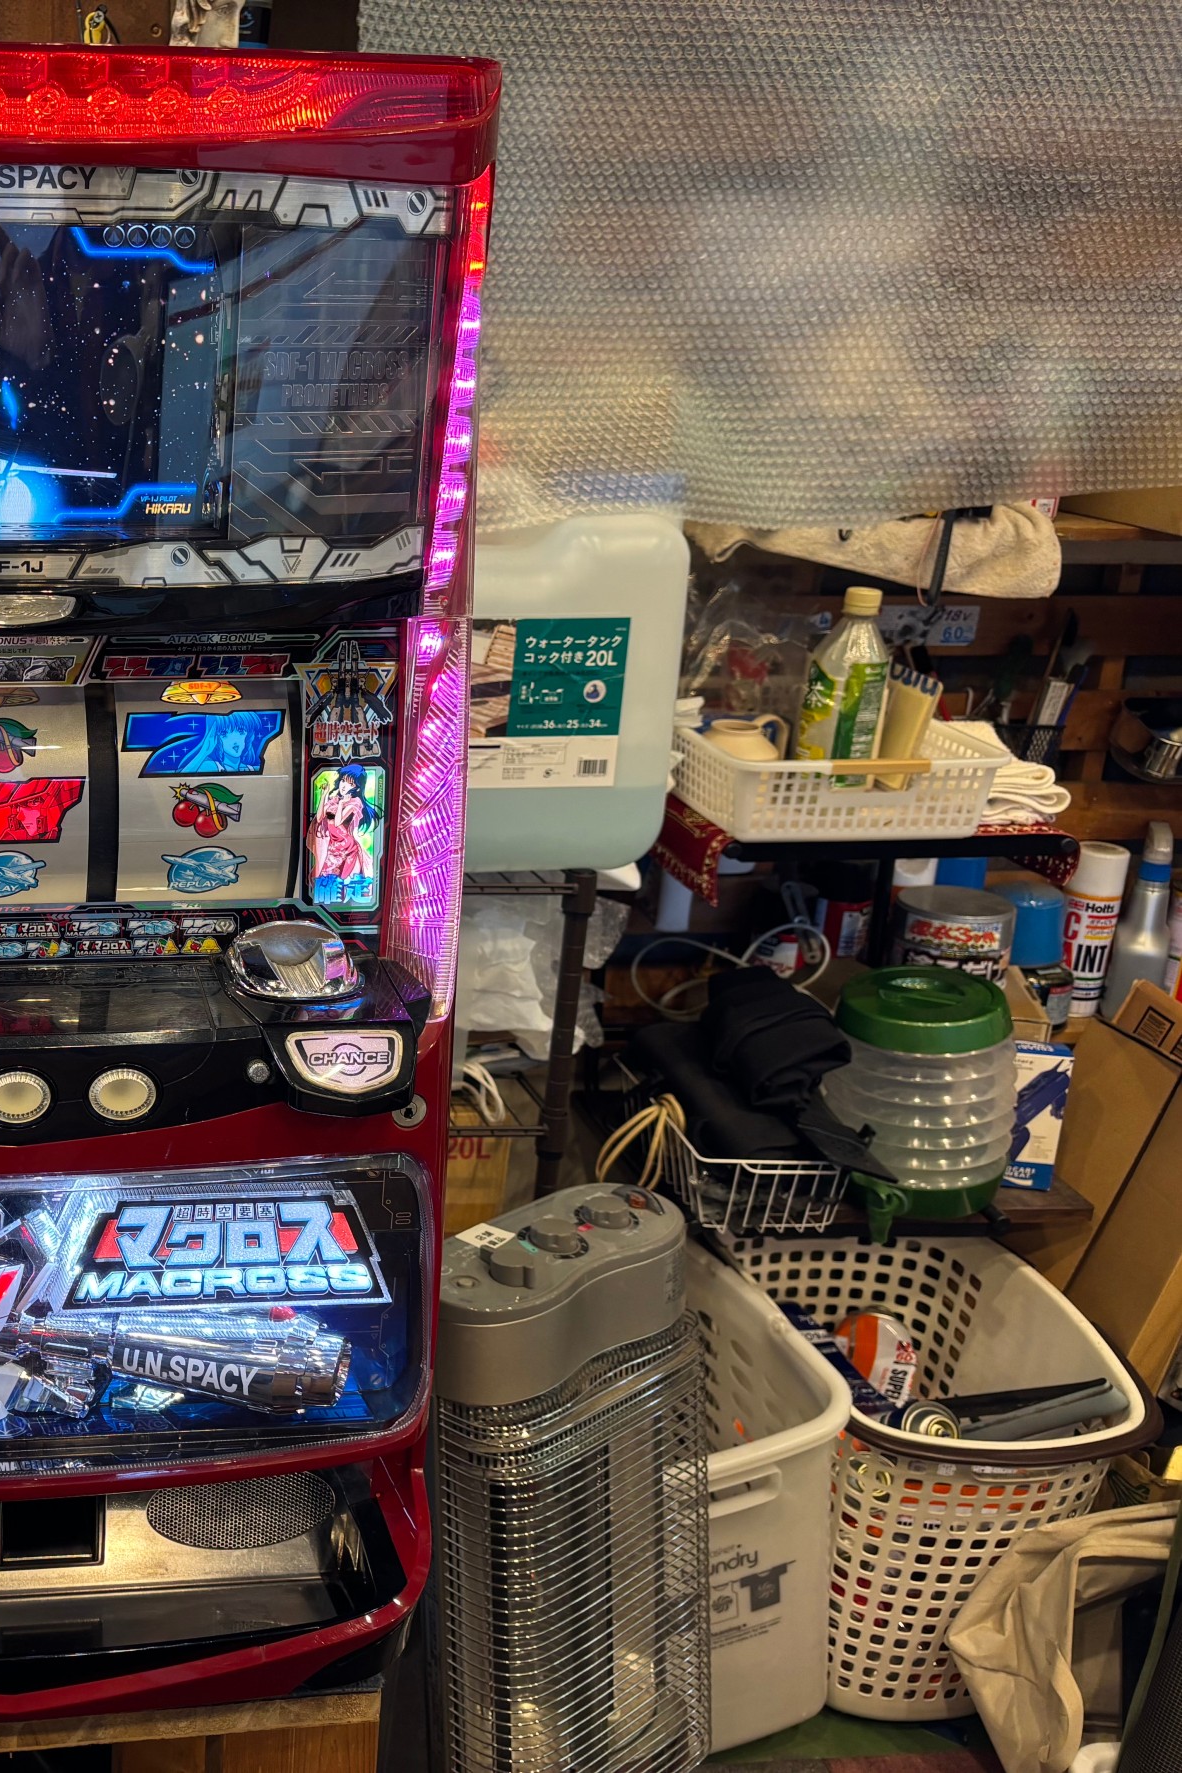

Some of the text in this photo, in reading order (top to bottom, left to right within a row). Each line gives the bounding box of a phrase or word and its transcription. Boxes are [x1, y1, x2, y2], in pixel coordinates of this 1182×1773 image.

[263, 351, 410, 380] SDF-1 MACROSS
[281, 383, 389, 407] PROMETHEUS
[145, 503, 192, 515] HIKARU
[164, 632, 267, 644] ATTACK BONUS
[524, 635, 623, 648] ウォータータンク
[313, 720, 379, 745] 超時空モード
[168, 879, 218, 889] REPLAY
[313, 875, 375, 905] 確定
[1084, 902, 1115, 914] Holts
[309, 1051, 392, 1066] CHANCE
[173, 1202, 277, 1222] 超時空要塞
[115, 1200, 352, 1272] マクロス
[77, 1263, 375, 1303] MACROSS
[122, 1346, 260, 1396] U.N.SPACY
